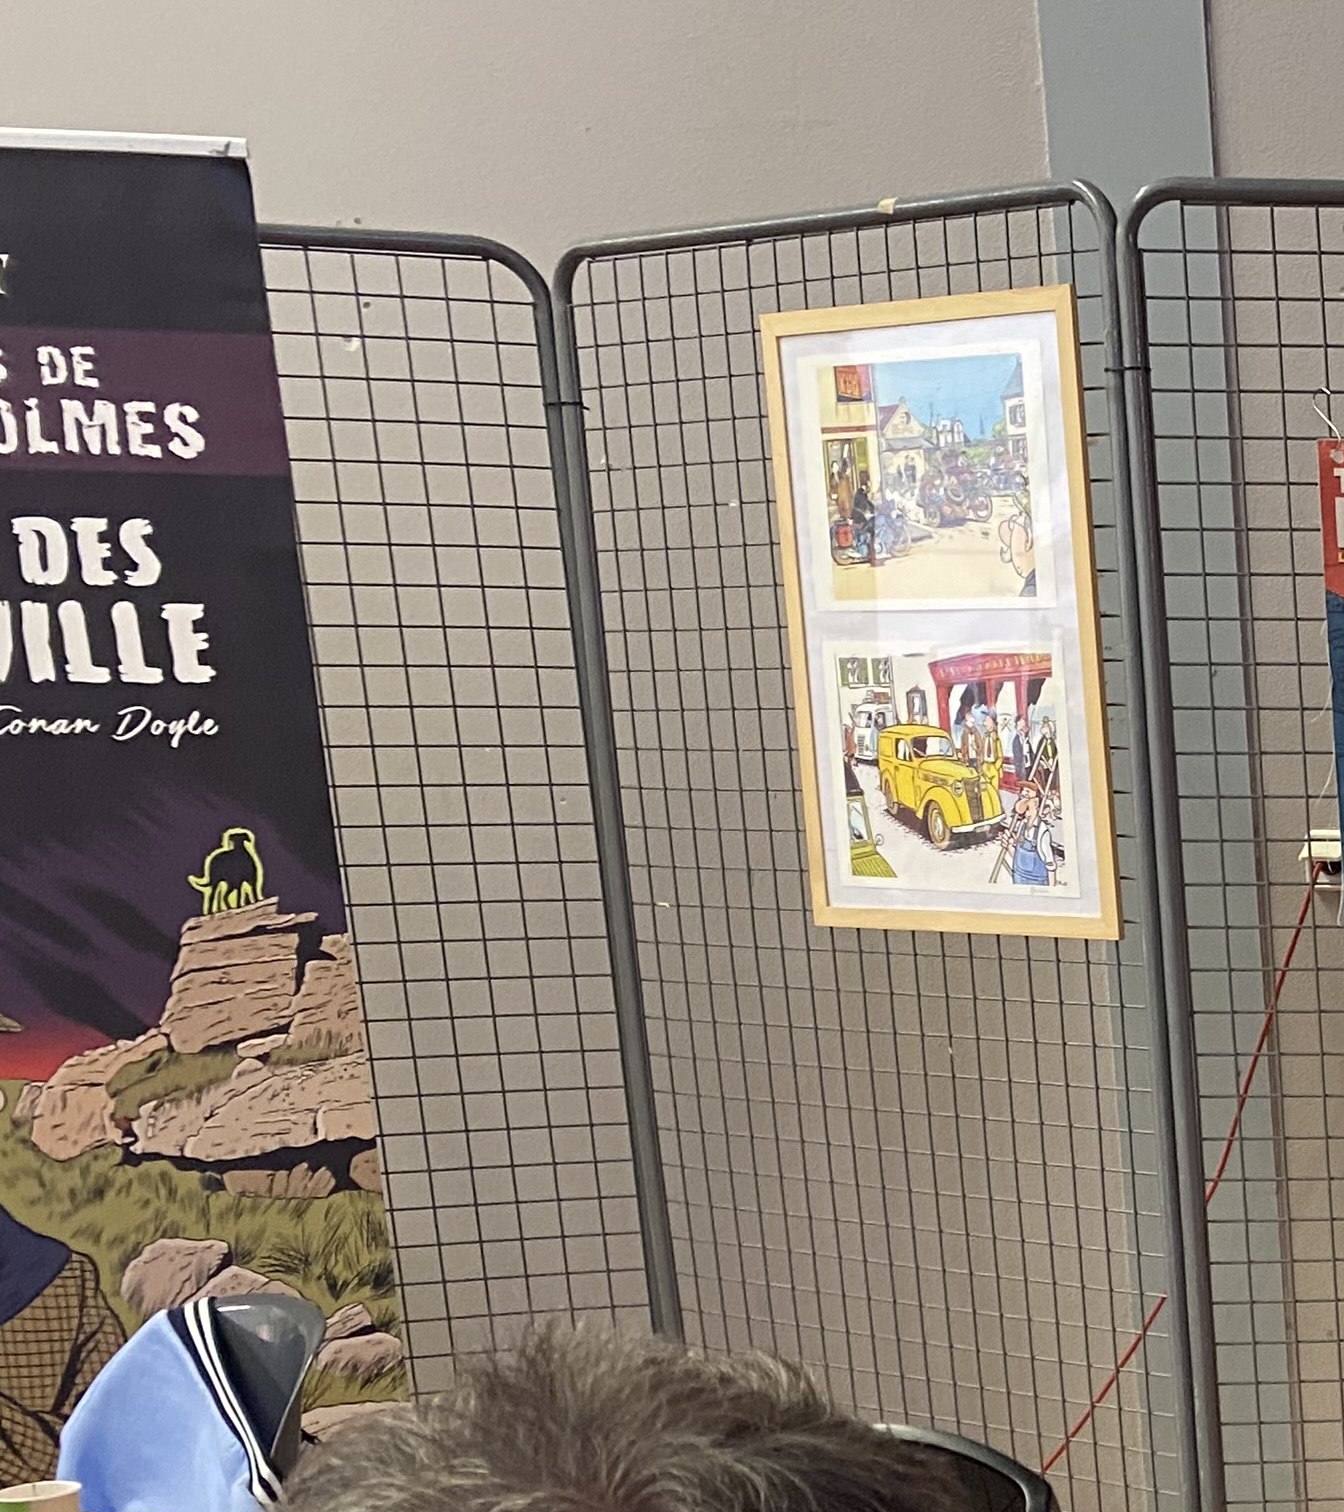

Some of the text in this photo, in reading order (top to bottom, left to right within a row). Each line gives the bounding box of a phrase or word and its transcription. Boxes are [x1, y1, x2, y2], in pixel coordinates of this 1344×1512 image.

[37, 346, 99, 387] DE
[11, 516, 162, 586] DES
[0, 600, 216, 683] ILLE
[110, 705, 219, 748] Doyle
